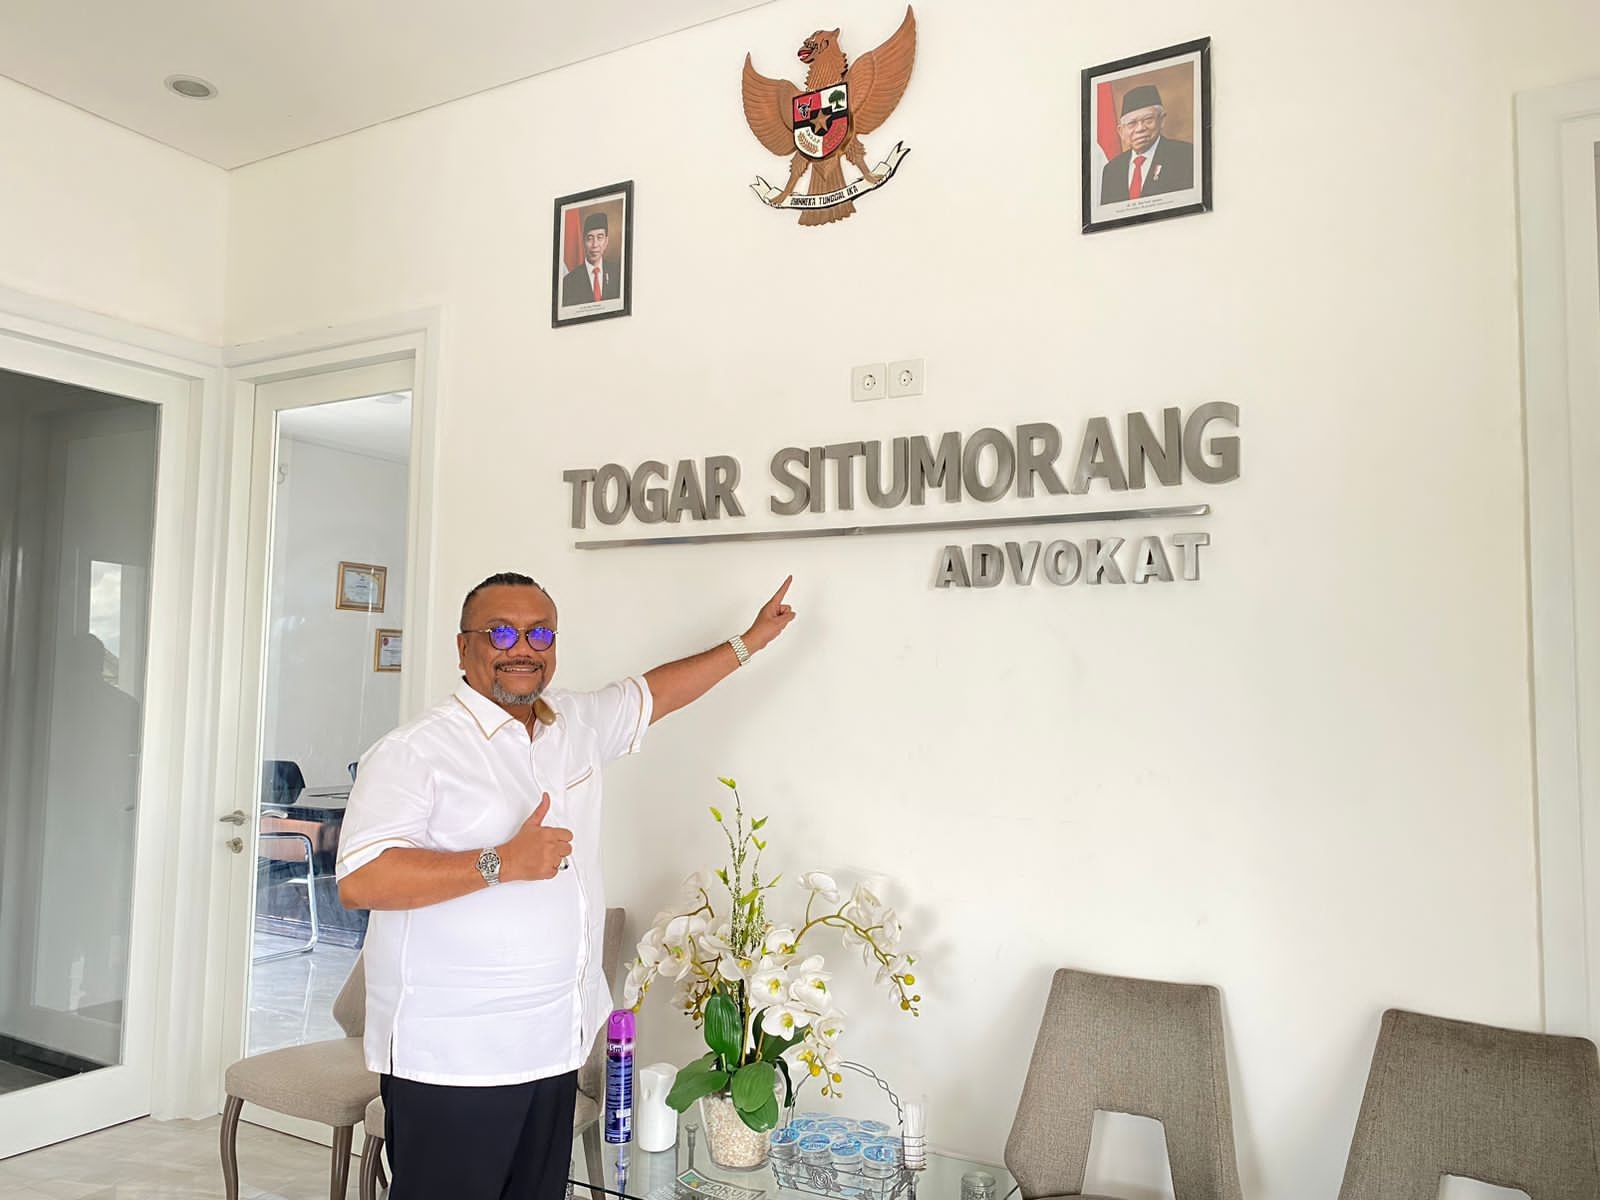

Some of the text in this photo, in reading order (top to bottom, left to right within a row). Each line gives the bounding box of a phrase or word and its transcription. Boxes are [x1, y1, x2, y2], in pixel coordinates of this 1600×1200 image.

[562, 401, 1241, 530] TOGAR SITUMORANG
[934, 532, 1211, 589] ADVOKAT
